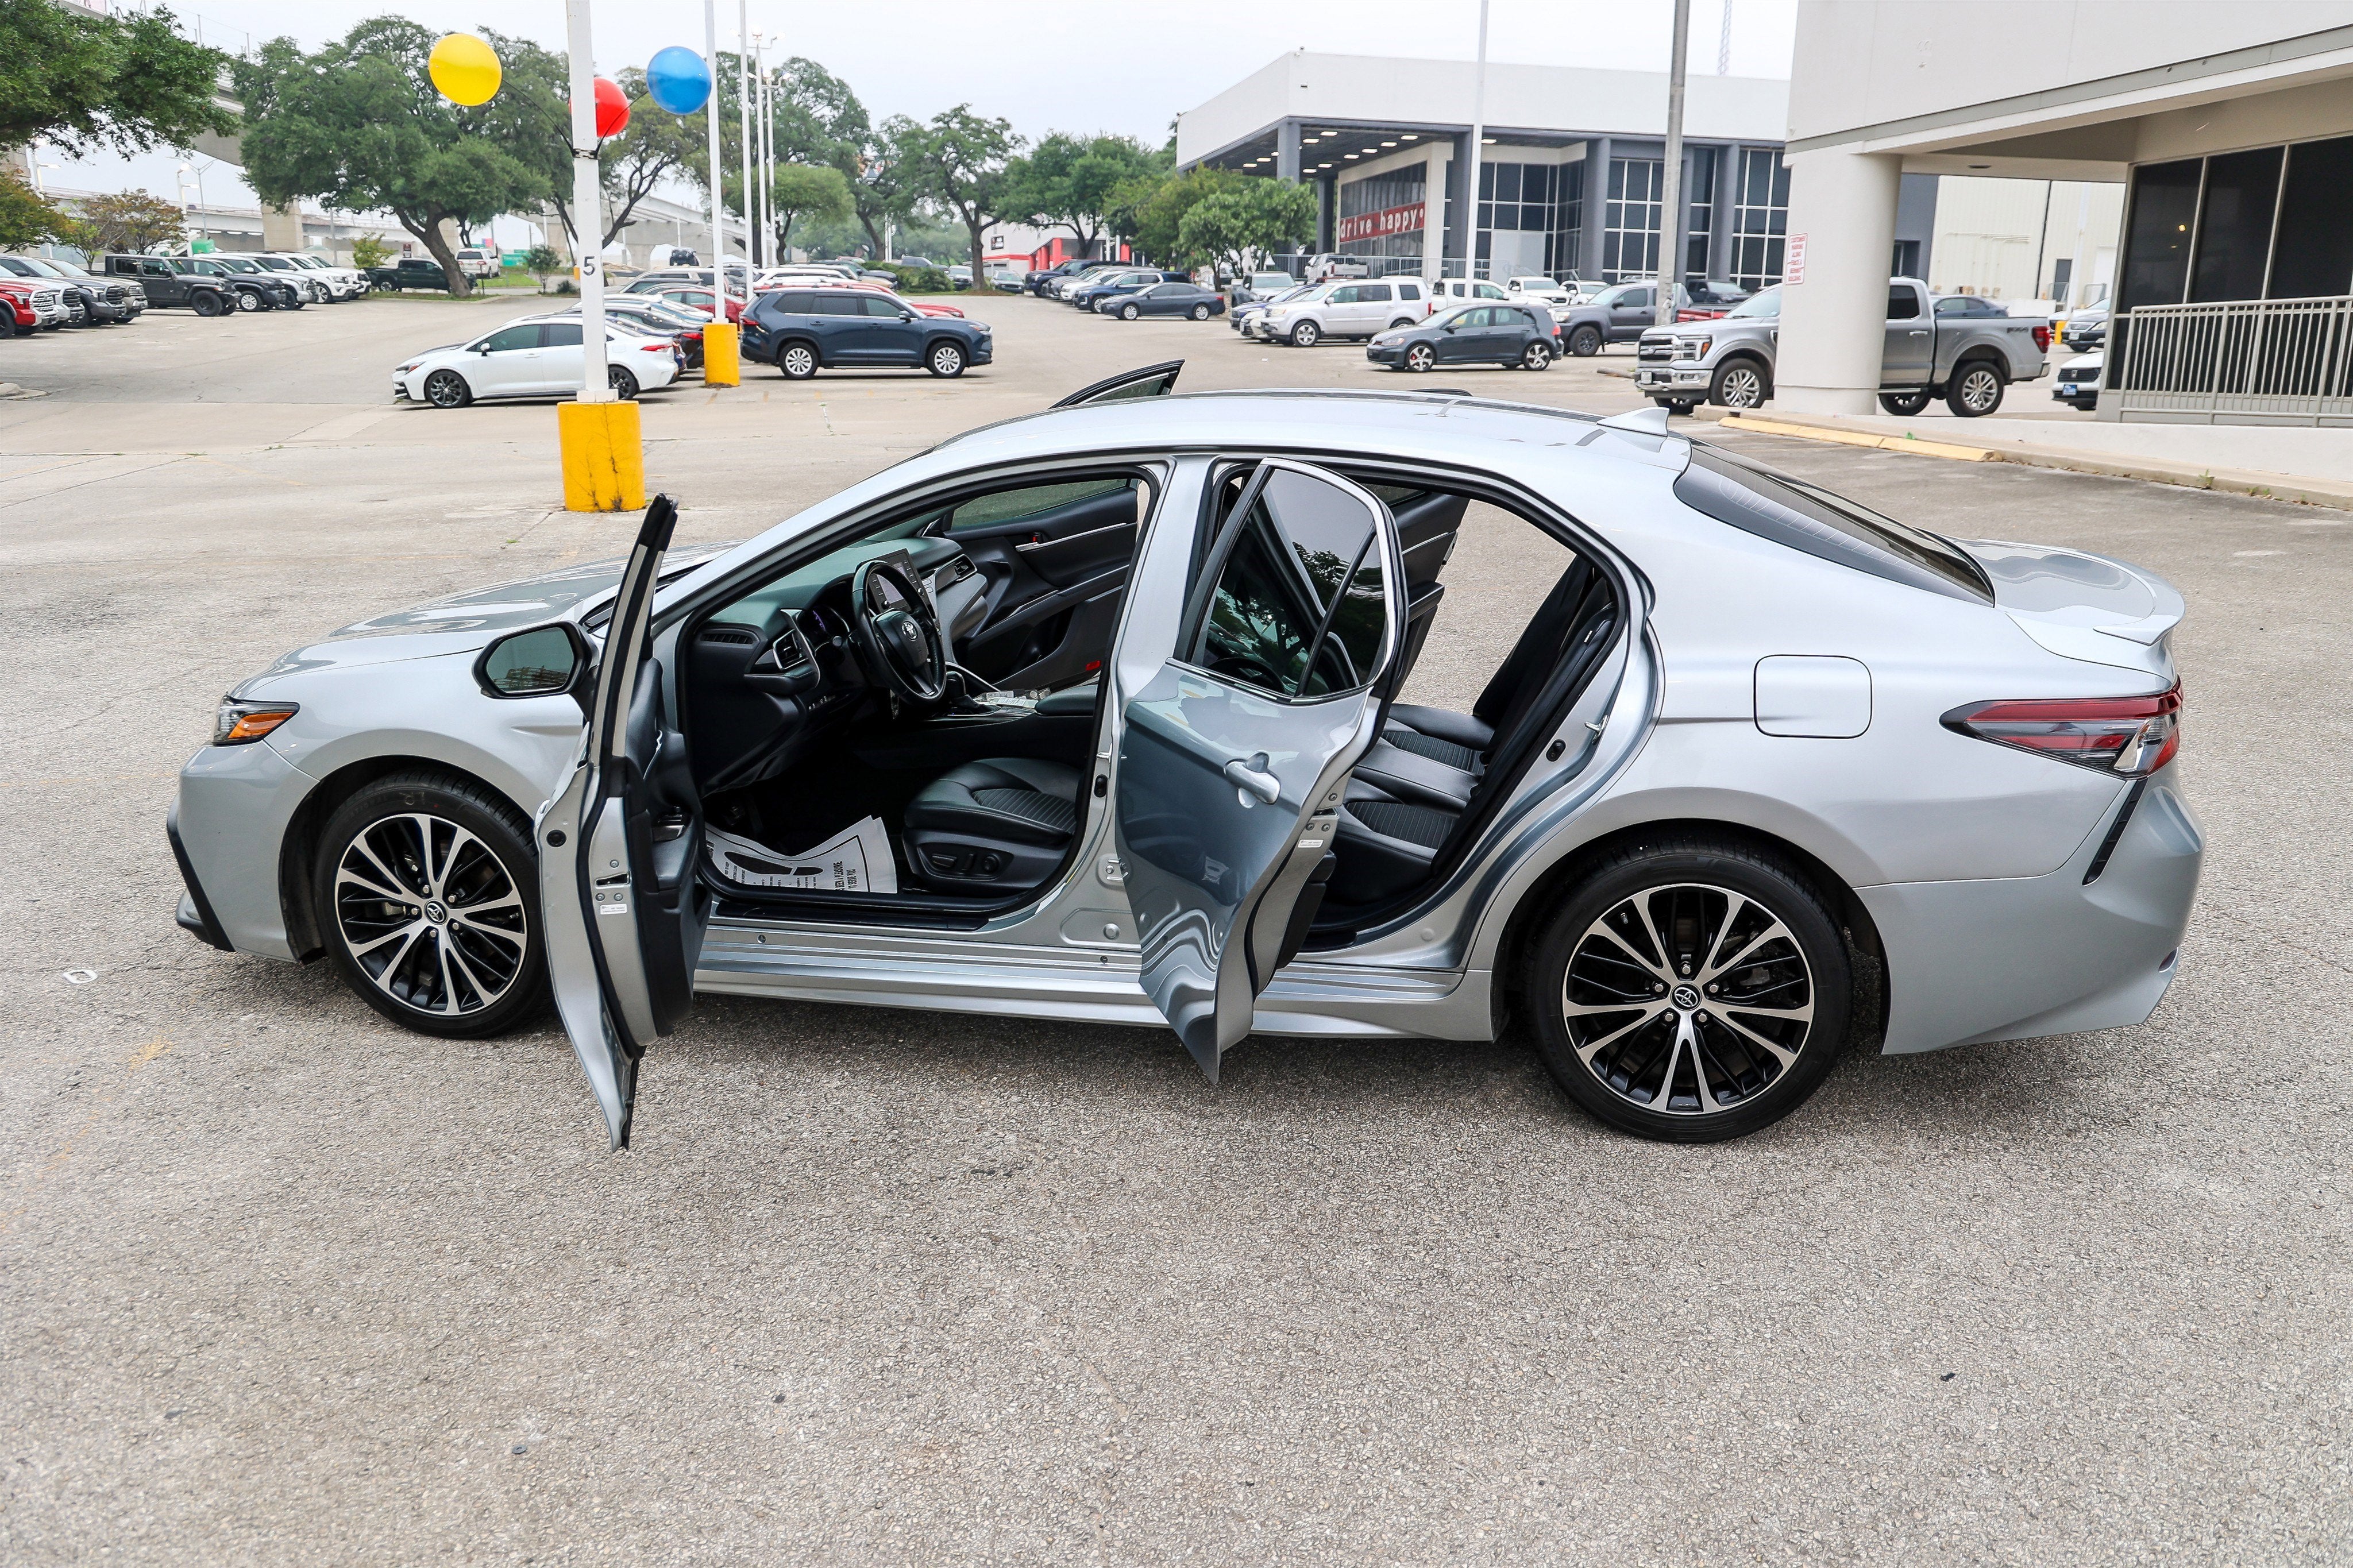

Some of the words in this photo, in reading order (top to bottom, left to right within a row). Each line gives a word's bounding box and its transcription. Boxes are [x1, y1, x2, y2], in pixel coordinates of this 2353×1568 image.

[1341, 216, 1372, 238] drive
[1380, 209, 1417, 233] happy
[583, 256, 595, 276] 5
[833, 861, 844, 878] PLEASURE
[847, 876, 857, 885] SERVE
